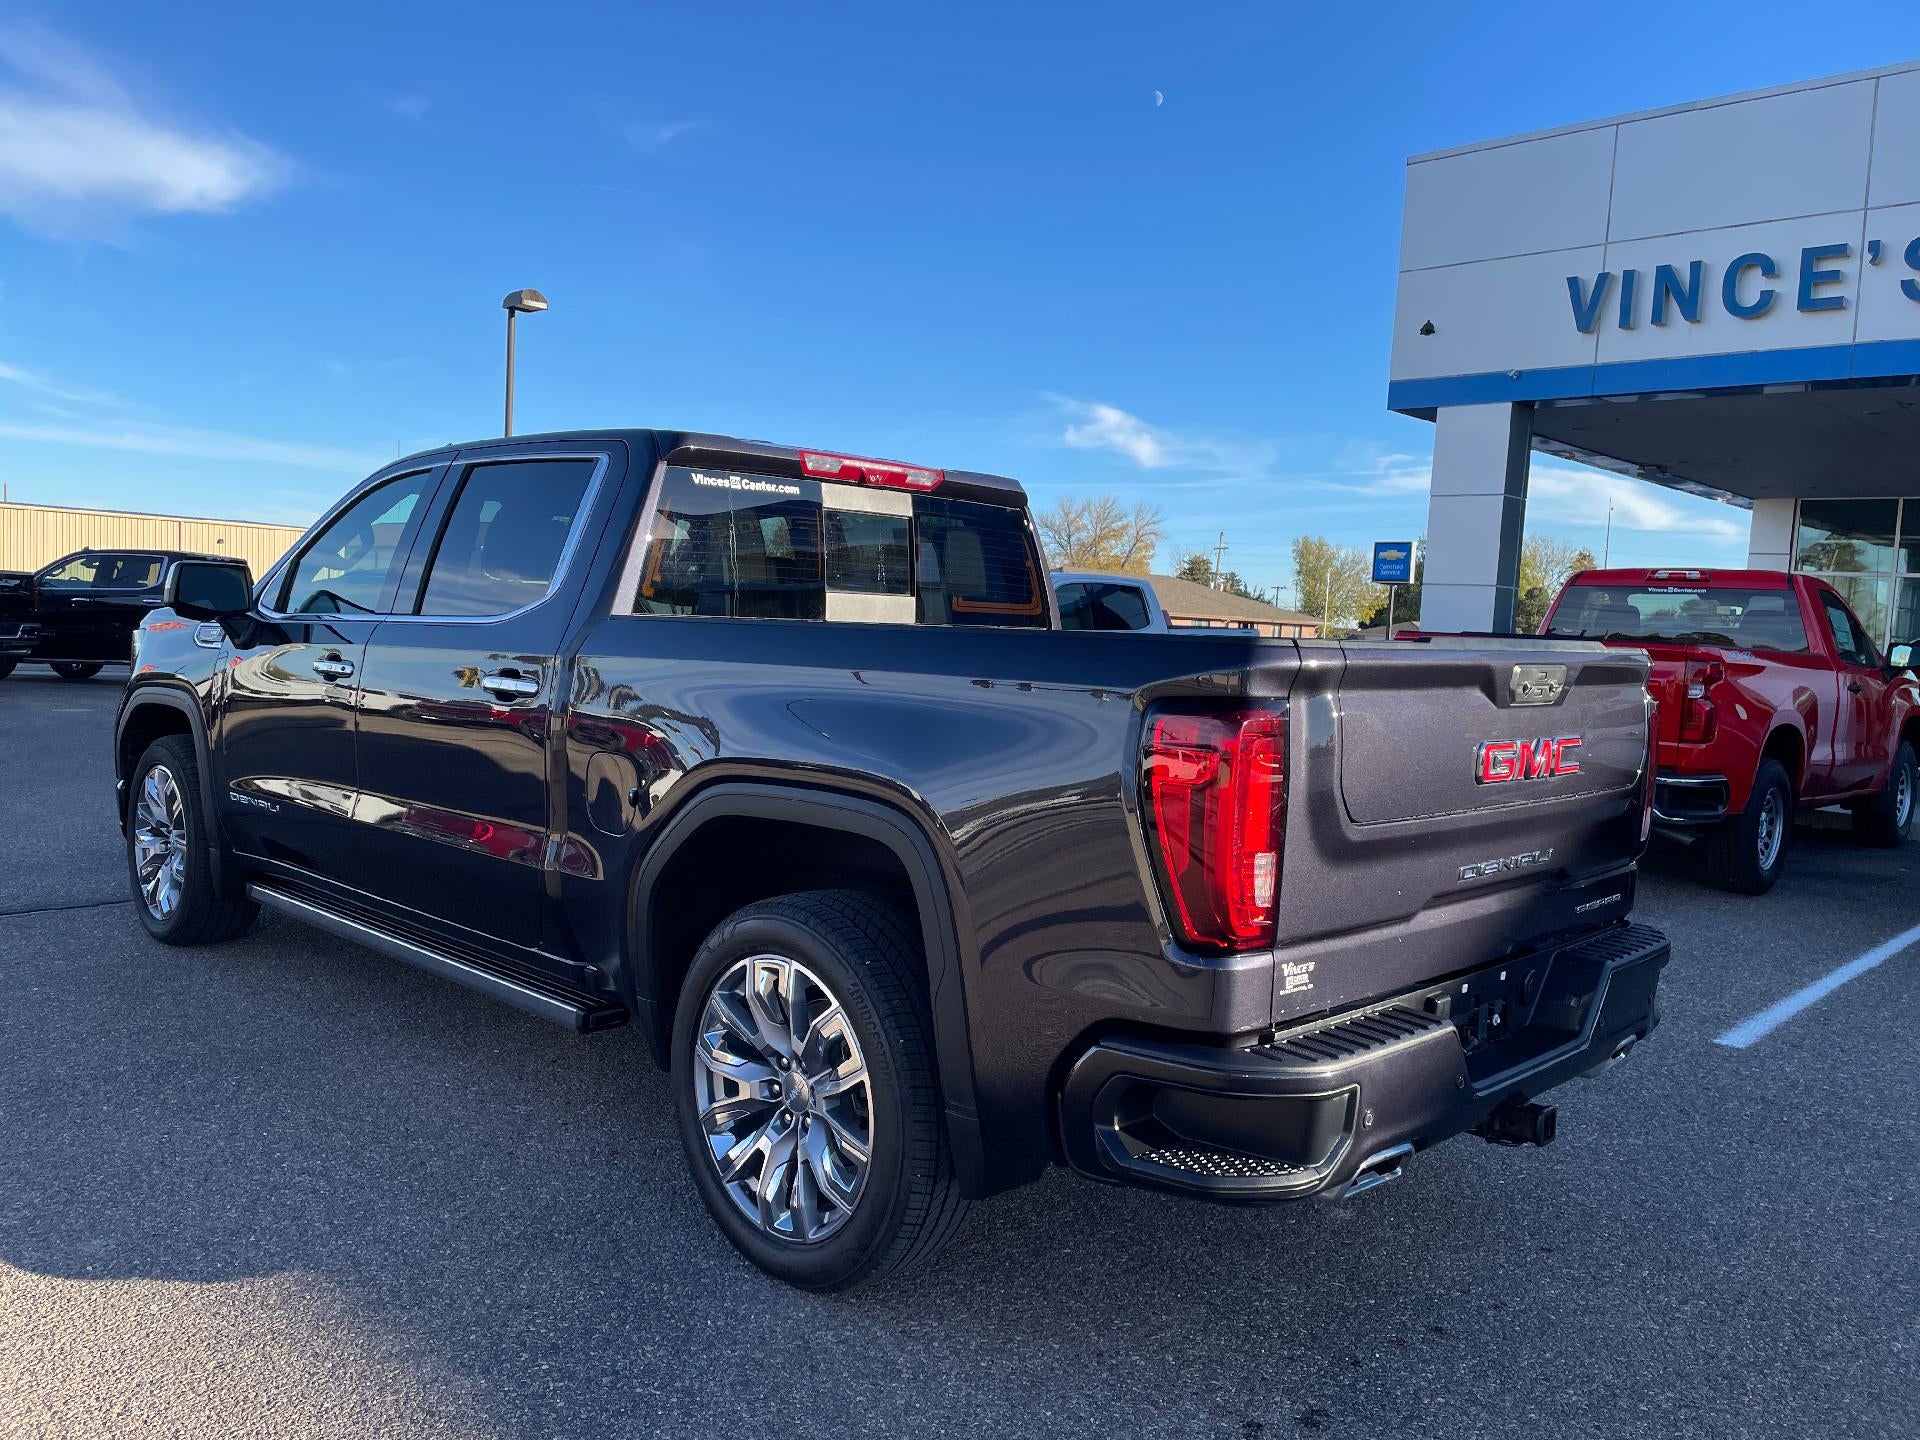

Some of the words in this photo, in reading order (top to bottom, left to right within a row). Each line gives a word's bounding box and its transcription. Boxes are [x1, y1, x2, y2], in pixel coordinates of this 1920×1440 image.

[1474, 735, 1582, 785] GMC
[229, 791, 280, 813] DENALI
[1457, 849, 1554, 881] DENALI
